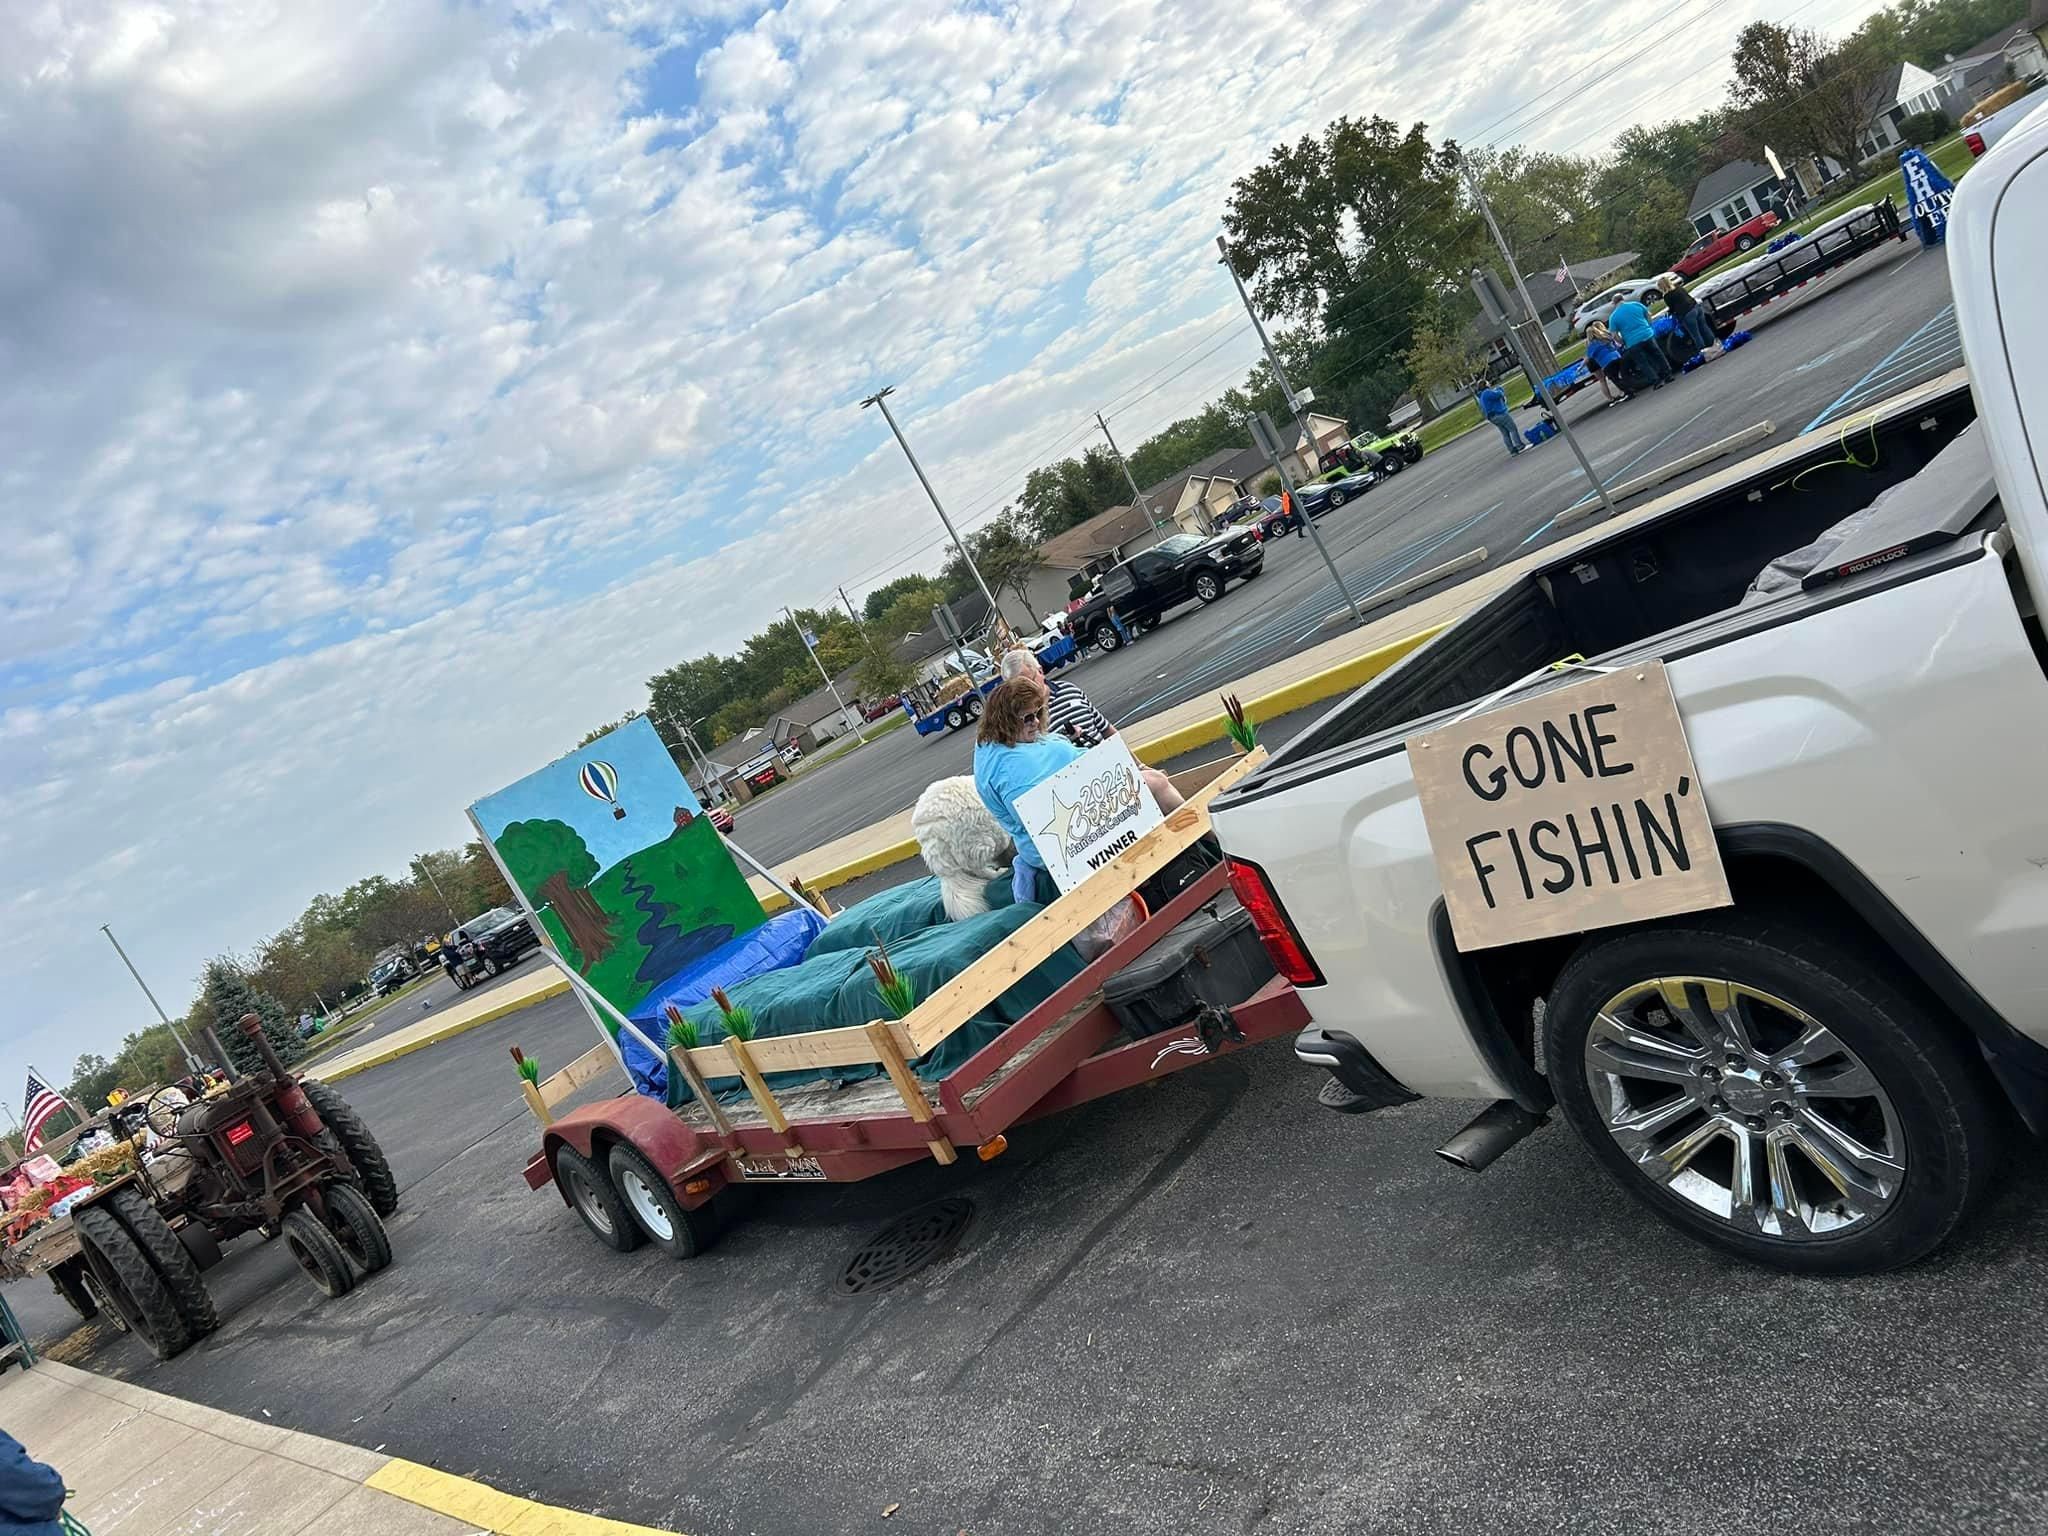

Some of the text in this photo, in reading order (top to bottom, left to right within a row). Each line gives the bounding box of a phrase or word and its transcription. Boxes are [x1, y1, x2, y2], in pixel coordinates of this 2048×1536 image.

[1462, 703, 1634, 801] GONE
[1080, 763, 1126, 812] 2024
[1067, 804, 1140, 858] Hancock County
[1086, 829, 1138, 870] WINNER
[1465, 776, 1691, 909] FISHIN'
